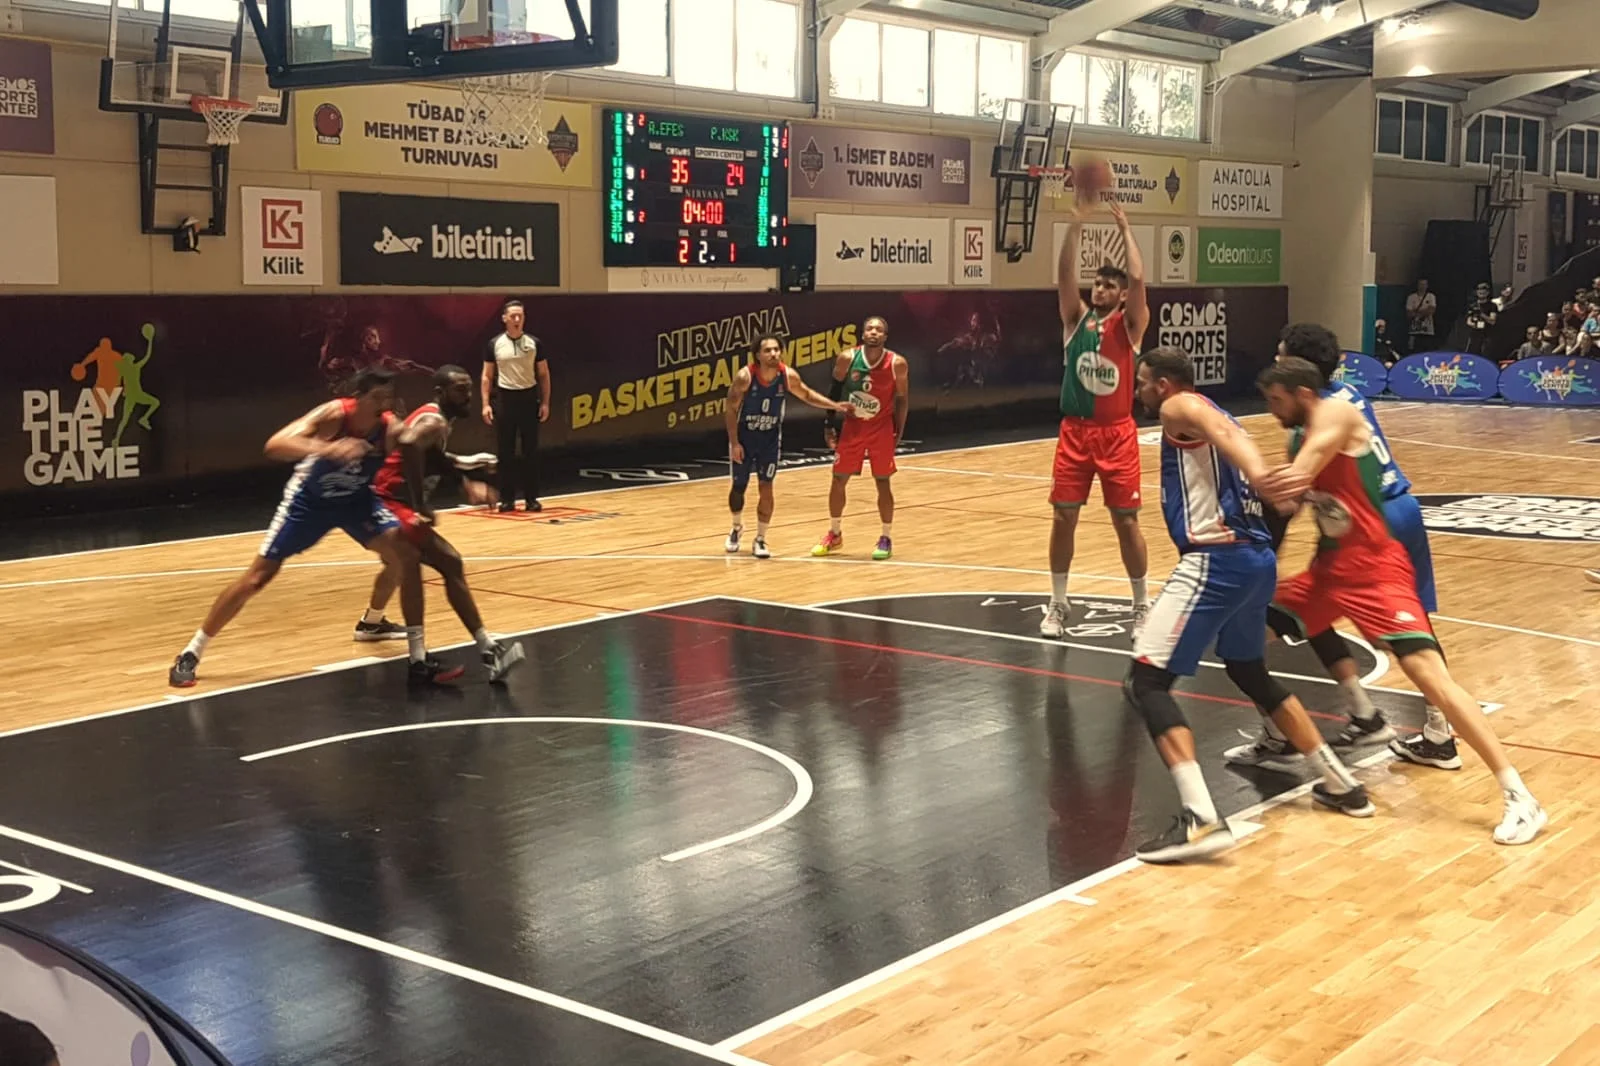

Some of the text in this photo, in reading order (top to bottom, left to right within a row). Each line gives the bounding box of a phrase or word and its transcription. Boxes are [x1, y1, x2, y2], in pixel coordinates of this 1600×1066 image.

[407, 100, 464, 122] TÜBAD
[364, 121, 439, 143] MEHMET
[401, 147, 498, 169] TURNUVASI
[833, 146, 842, 163] 1.
[847, 143, 886, 166] İSMET
[890, 150, 934, 168] BADEM
[672, 159, 688, 183] 35
[726, 163, 744, 187] 24
[847, 170, 922, 189] TURNUVASI
[1213, 168, 1271, 187] ANATOLIA
[683, 200, 723, 224] 04:00
[1212, 193, 1271, 212] HOSPITAL
[432, 224, 534, 261] biletinial
[679, 239, 688, 263] 2
[730, 243, 735, 262] 1
[871, 238, 932, 264] biletinial
[1207, 242, 1273, 263] Odeontours
[263, 257, 304, 275] Kilit
[964, 265, 983, 278] Kilit
[1160, 303, 1226, 326] COSMOS
[658, 306, 790, 368] NIRVANA
[1161, 331, 1225, 354] SPORTS
[1194, 356, 1224, 380] TER
[23, 387, 123, 424] PLAY
[667, 412, 677, 428] 9
[688, 404, 701, 422] 17
[761, 398, 770, 413] 0
[23, 413, 103, 455] THE
[24, 445, 140, 486] GAME
[766, 463, 776, 478] 0
